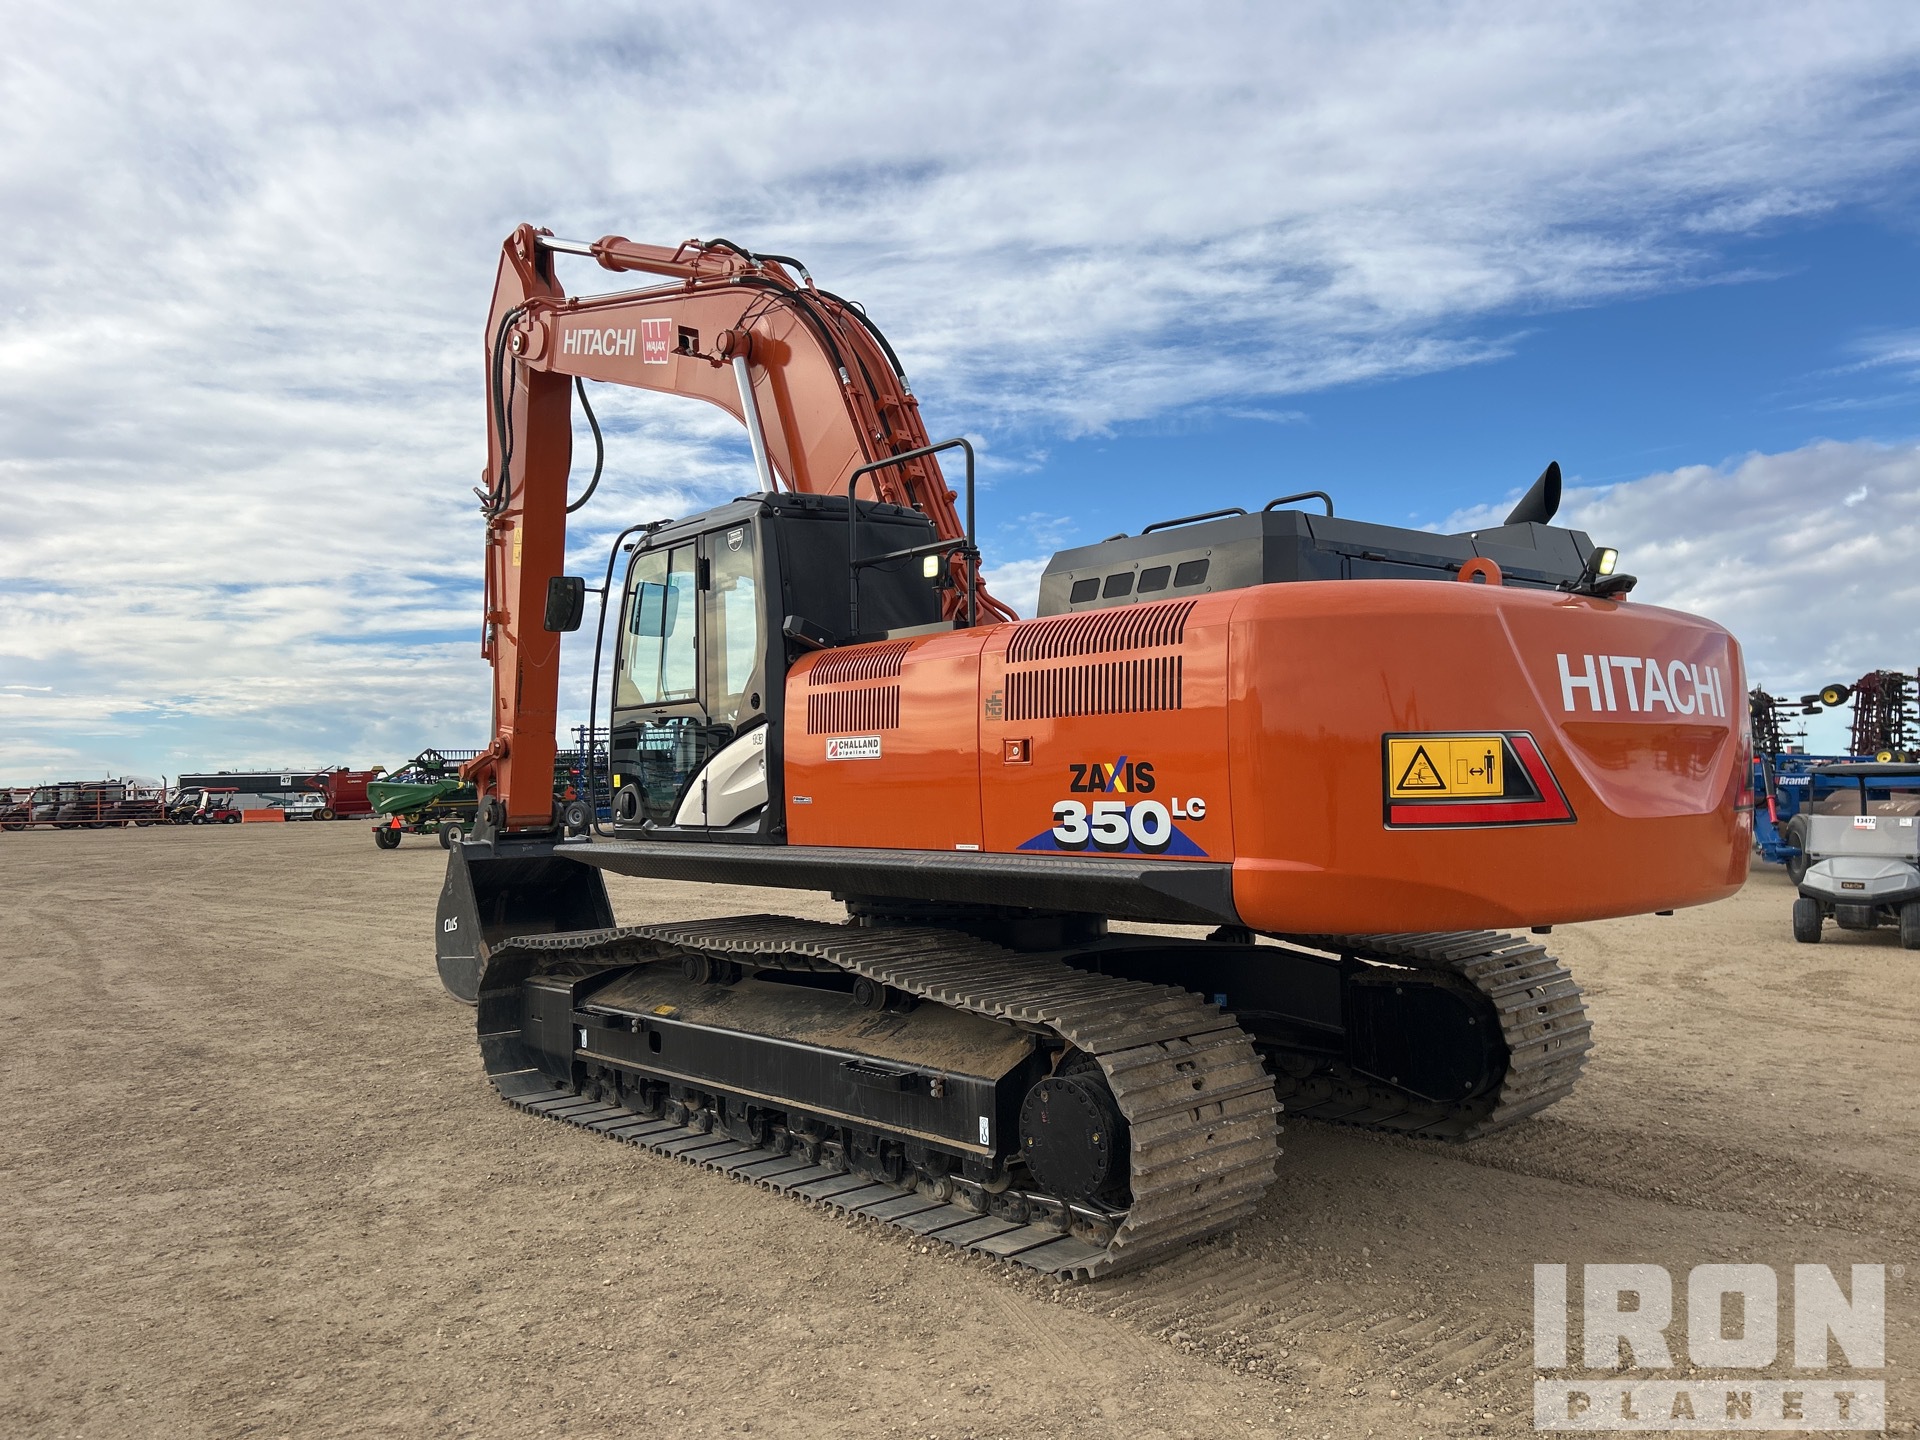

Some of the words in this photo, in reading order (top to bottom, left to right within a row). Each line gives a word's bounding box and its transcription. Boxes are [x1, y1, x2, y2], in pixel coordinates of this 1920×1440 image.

[563, 328, 636, 356] HITACHI
[646, 341, 666, 354] WAJAX
[1556, 653, 1726, 718] HITACHI
[838, 739, 879, 749] CHALLAND
[1069, 755, 1156, 794] ZAXIS
[1779, 776, 1810, 785] Brandt
